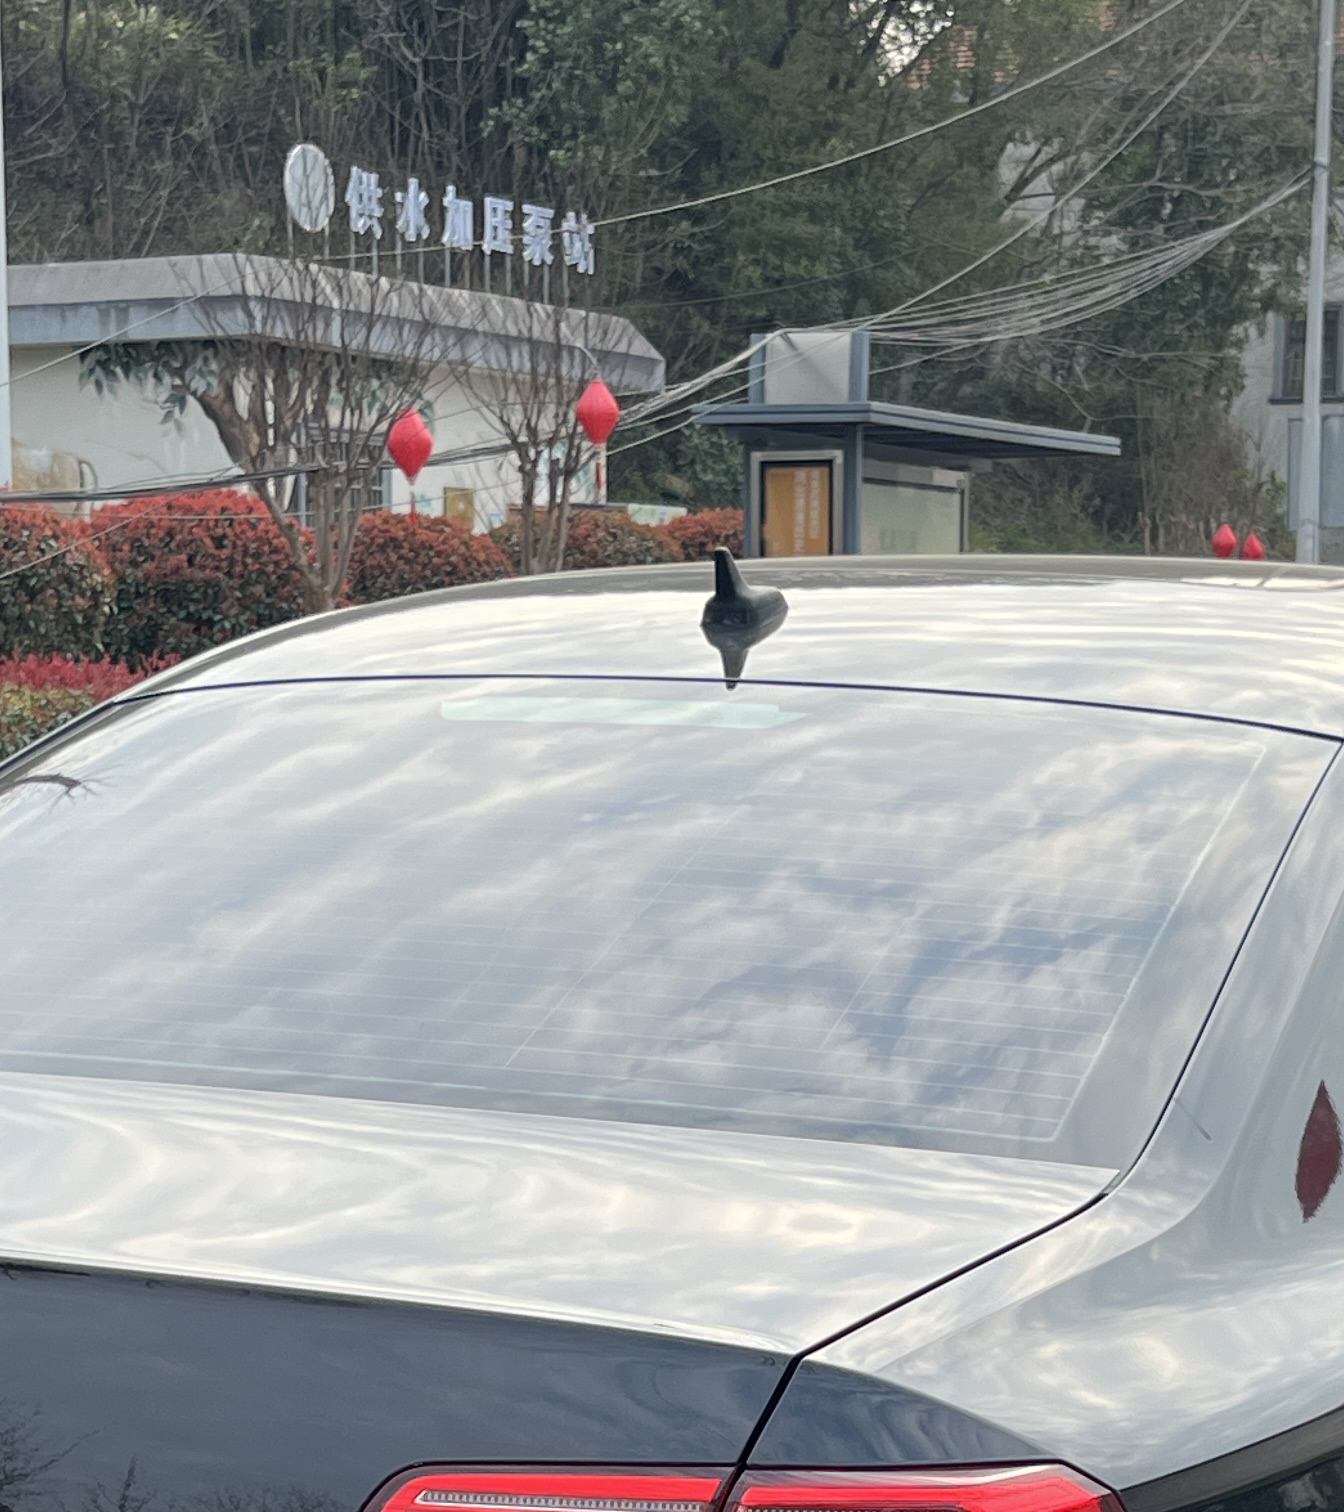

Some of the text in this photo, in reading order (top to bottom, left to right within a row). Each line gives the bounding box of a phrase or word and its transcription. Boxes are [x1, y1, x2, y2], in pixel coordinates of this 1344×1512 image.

[344, 165, 595, 275] 供水加压泵站
